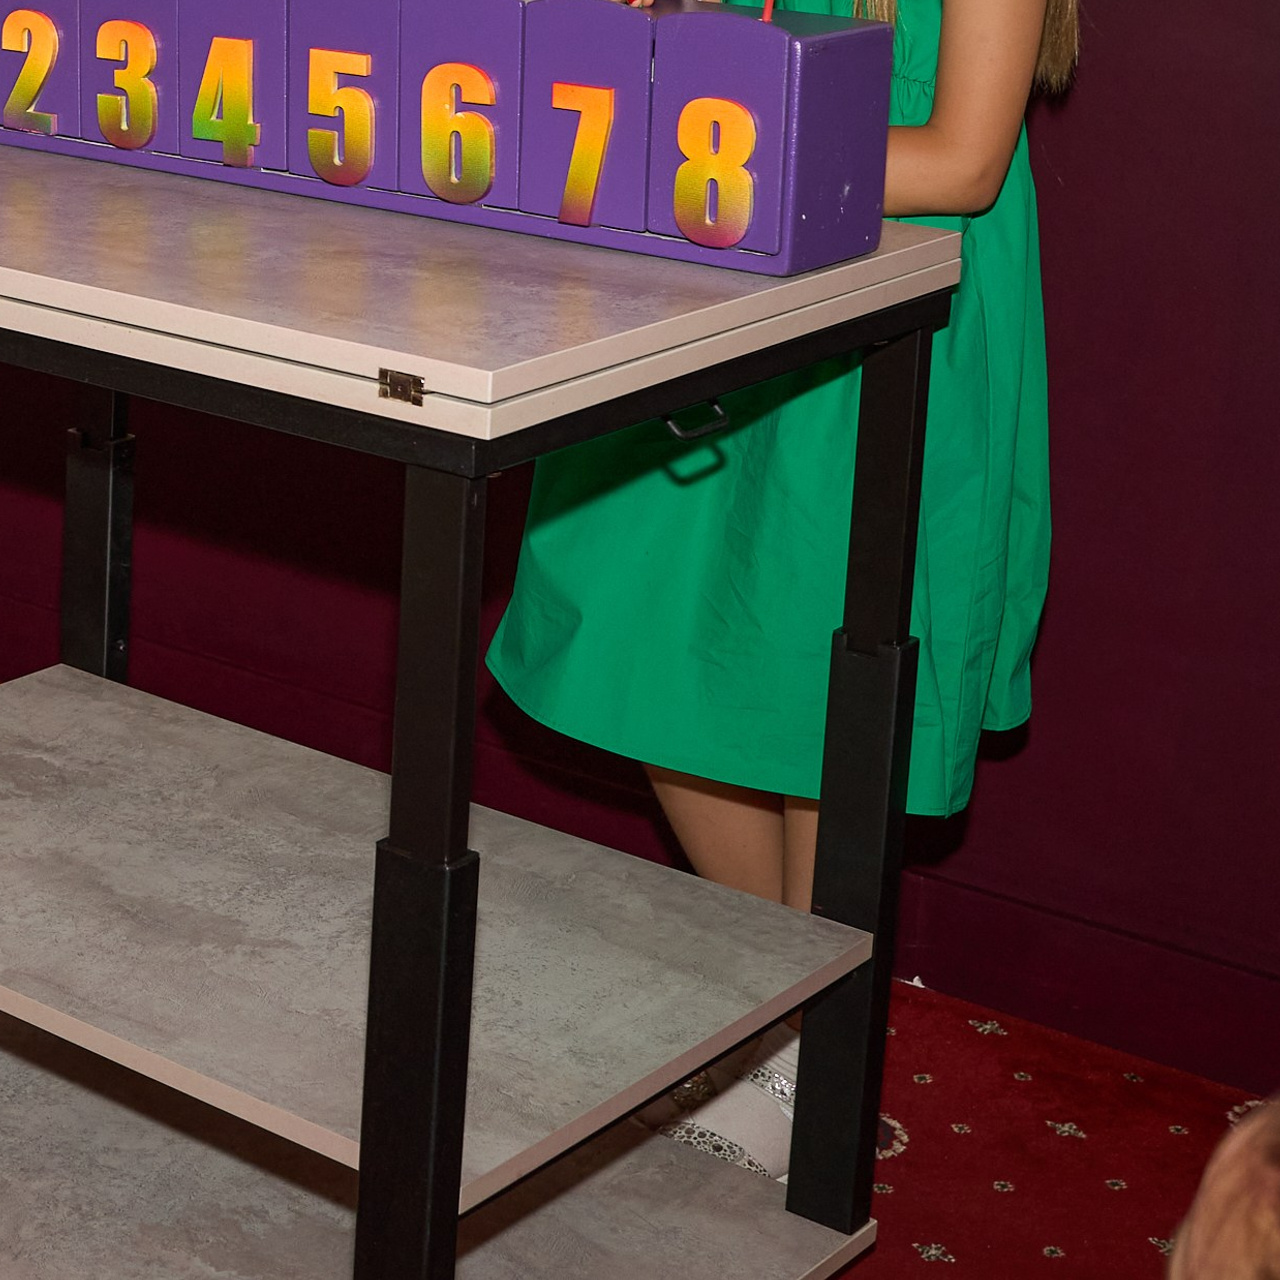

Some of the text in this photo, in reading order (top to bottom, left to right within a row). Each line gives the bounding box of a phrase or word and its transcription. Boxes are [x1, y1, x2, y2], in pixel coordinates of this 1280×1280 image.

[0, 8, 59, 135] 2
[95, 19, 159, 150] 3
[191, 36, 261, 168] 4
[306, 47, 376, 187] 5
[420, 61, 498, 206] 6
[551, 81, 616, 226] 7
[672, 96, 758, 249] 8
